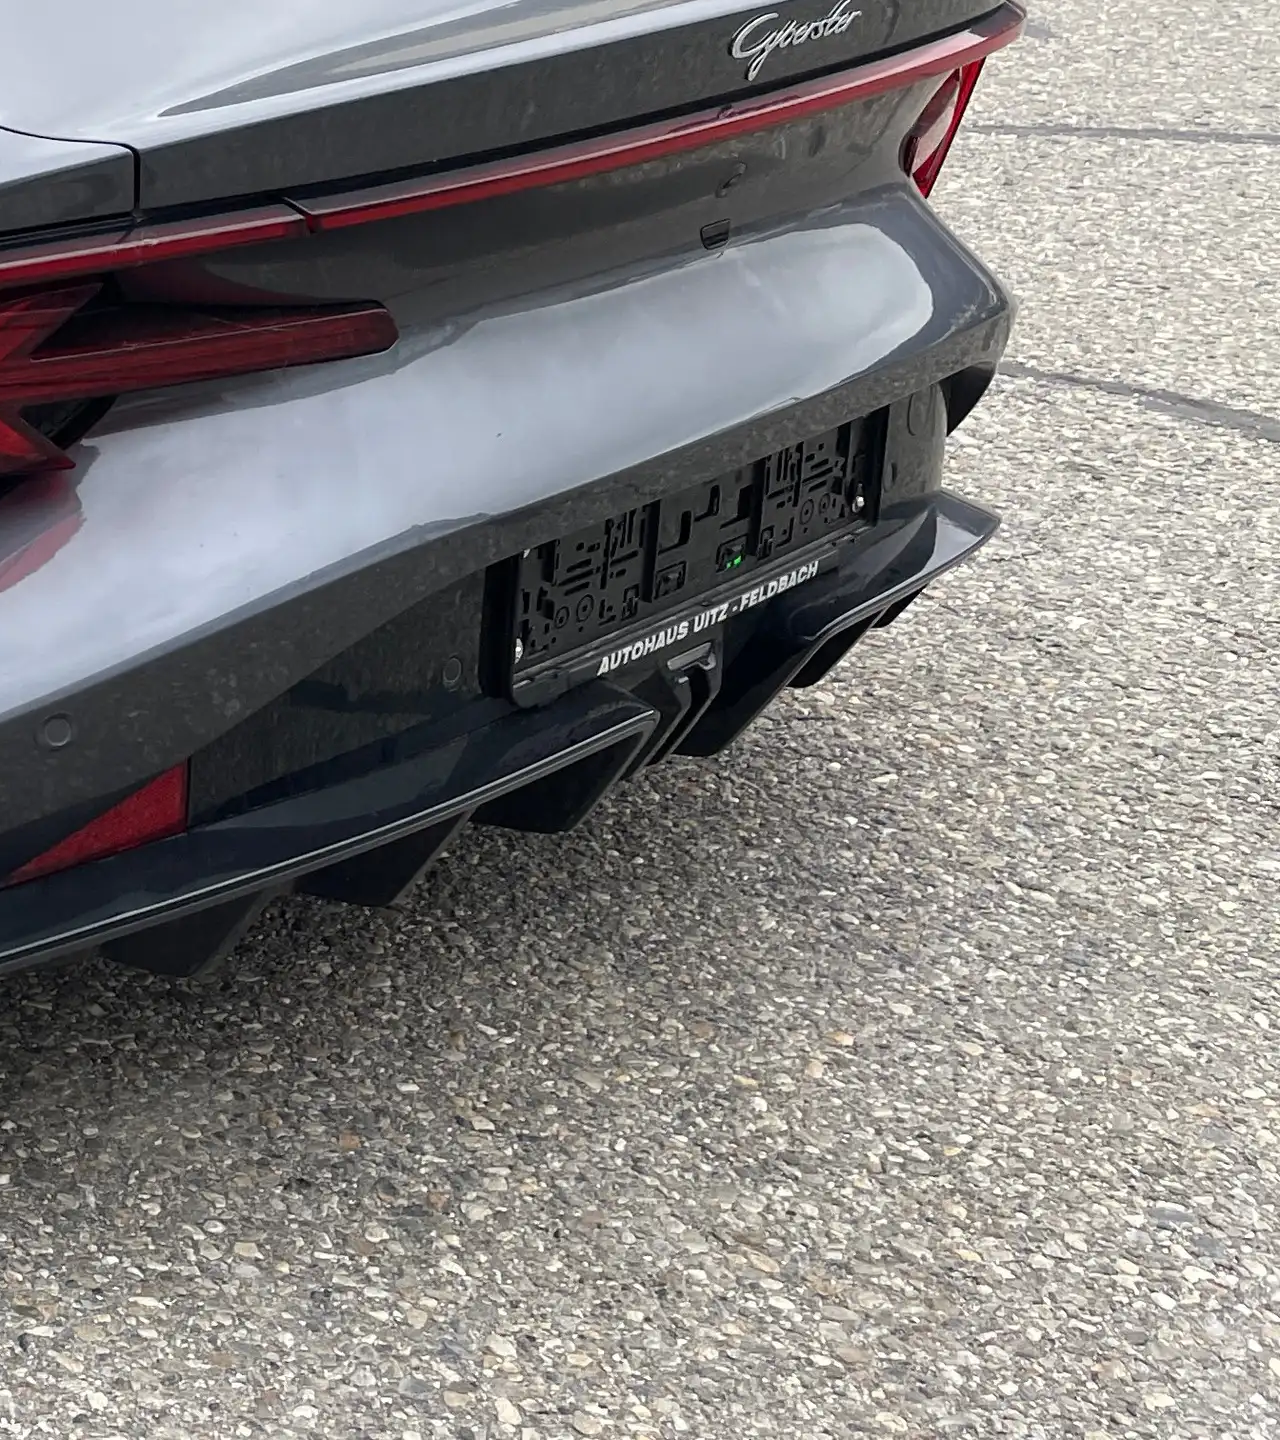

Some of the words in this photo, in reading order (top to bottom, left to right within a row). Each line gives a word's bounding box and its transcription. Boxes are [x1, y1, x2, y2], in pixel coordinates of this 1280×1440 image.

[597, 621, 690, 677] AUTOHAUS
[693, 602, 730, 633] UITZ
[740, 560, 819, 612] FELDBACH
